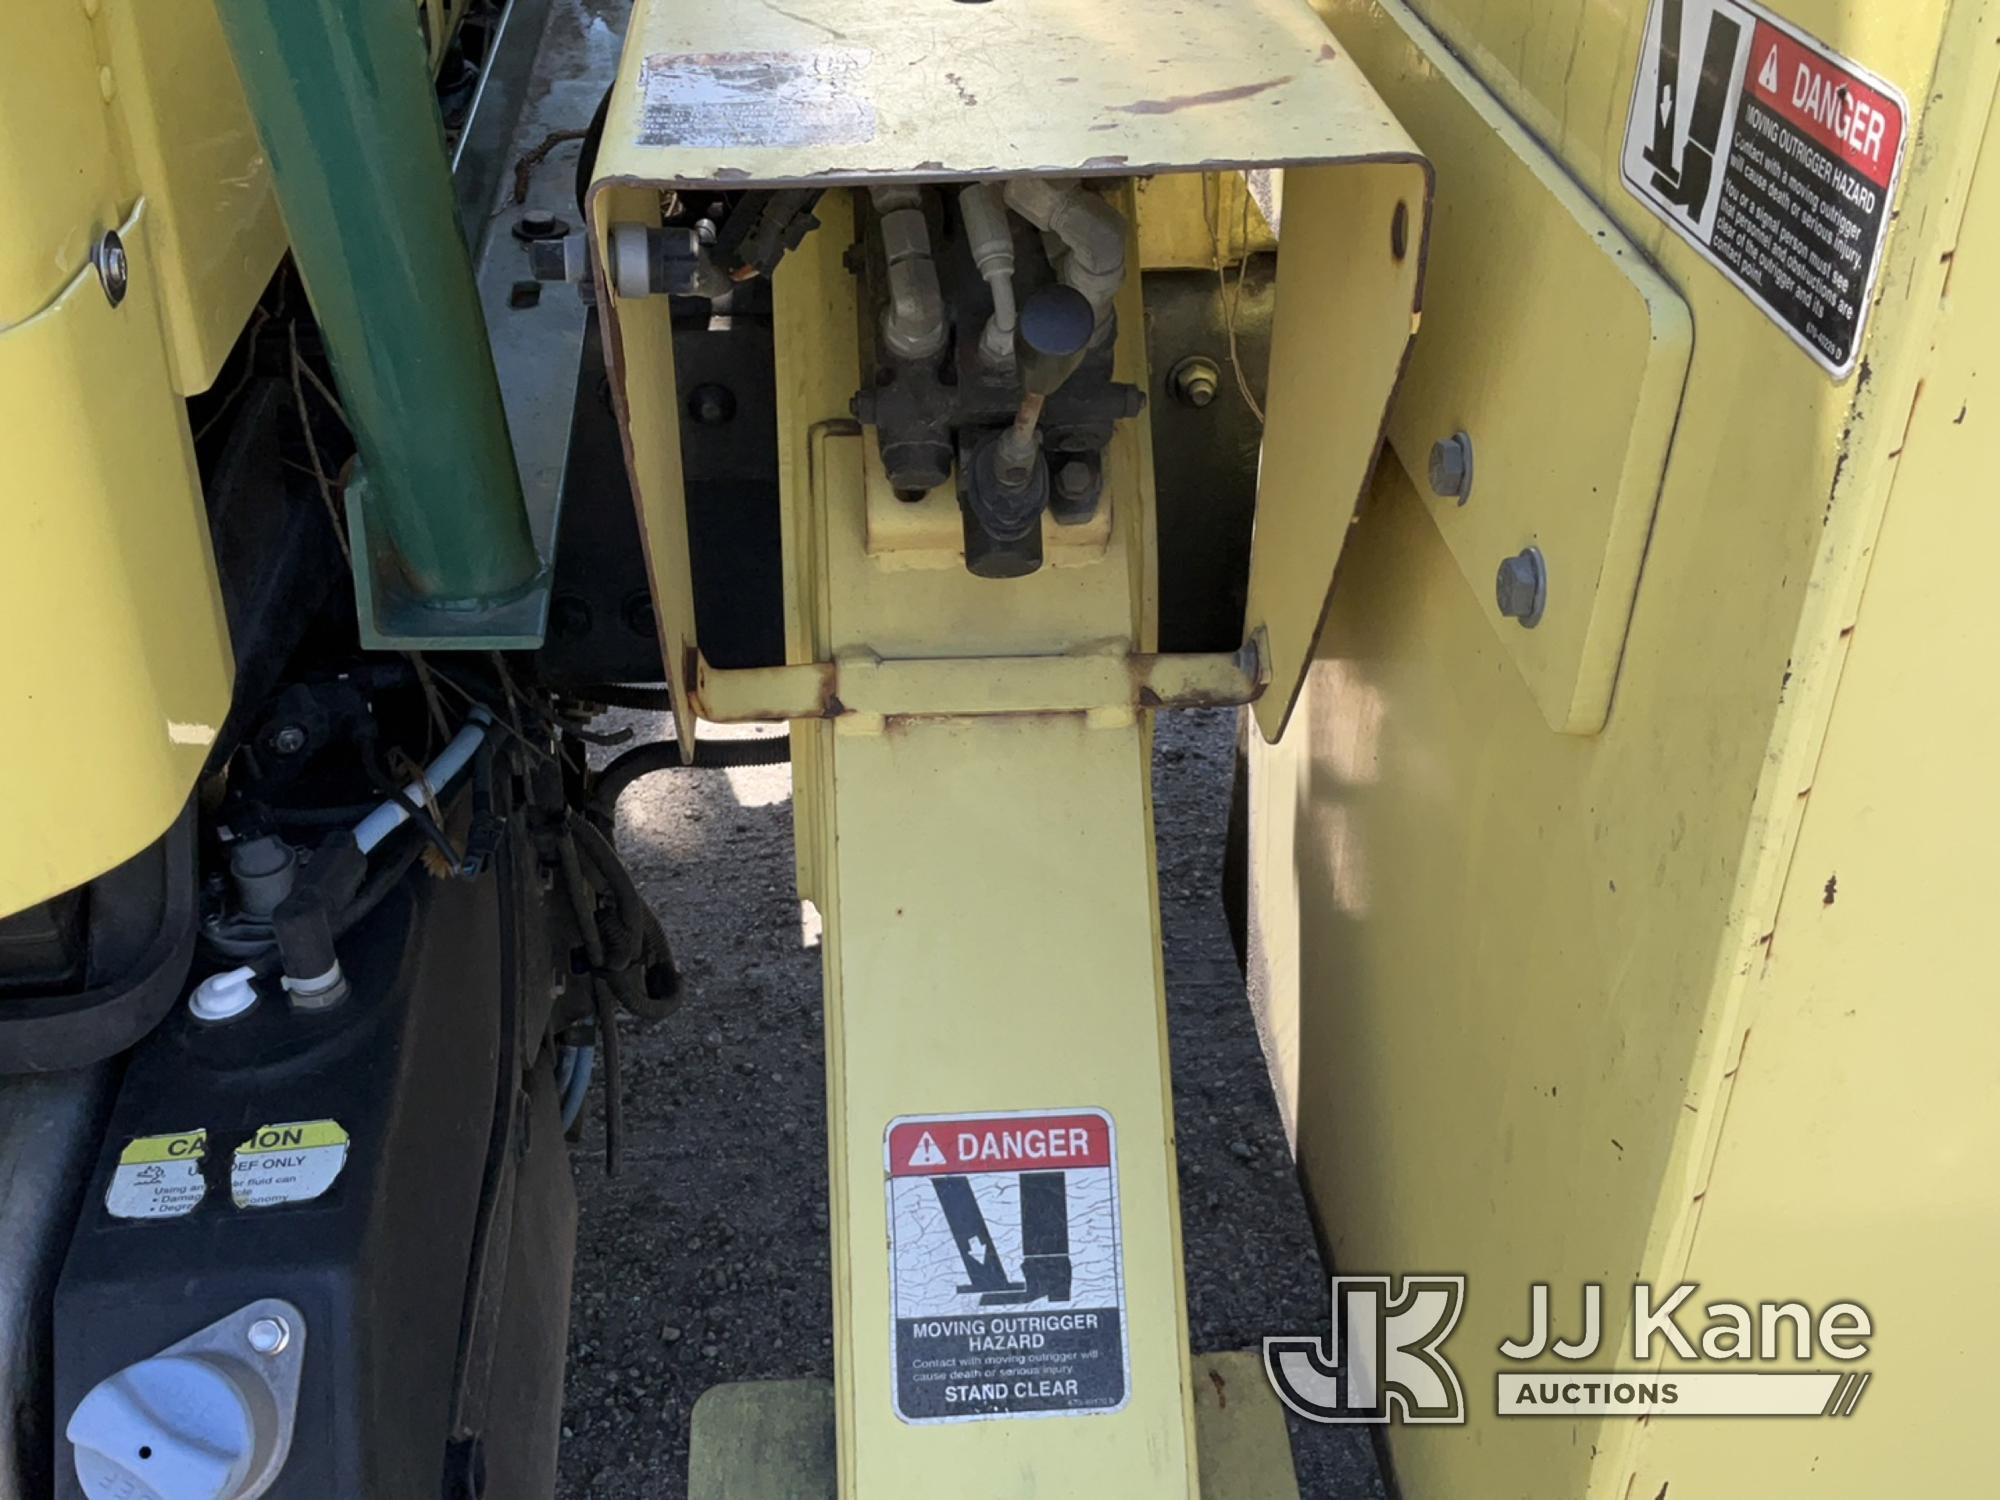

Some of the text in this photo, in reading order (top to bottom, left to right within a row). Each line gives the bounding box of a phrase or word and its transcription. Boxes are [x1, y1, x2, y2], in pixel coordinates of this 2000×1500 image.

[1791, 62, 1886, 162] DANGER
[1745, 103, 1875, 214] MOVING OUTRIGGER HAZARD
[1734, 131, 1861, 241] Contact with a moving outrigger
[1730, 153, 1862, 270] will cause death or serious injury.
[1713, 235, 1741, 267] contact
[1725, 177, 1849, 293] You or a signal person must see
[1716, 217, 1825, 318] clear of the outrigger and its
[1720, 196, 1853, 320] that personnel and obstructions are
[958, 1127, 1089, 1161] DANGER
[262, 1155, 307, 1170] ONLY
[154, 1186, 188, 1196] Using
[247, 1176, 274, 1187] fluid
[275, 1176, 297, 1184] can
[912, 1314, 1099, 1339] MOVING OUTRIGGER
[968, 1333, 1045, 1352] HAZARD
[912, 1349, 1099, 1369] Contact with moving outrigger will
[912, 1373, 947, 1383] cause
[949, 1367, 982, 1380] death
[984, 1368, 996, 1378] or
[999, 1365, 1041, 1378] serious
[944, 1379, 1079, 1403] STAND CLEAR
